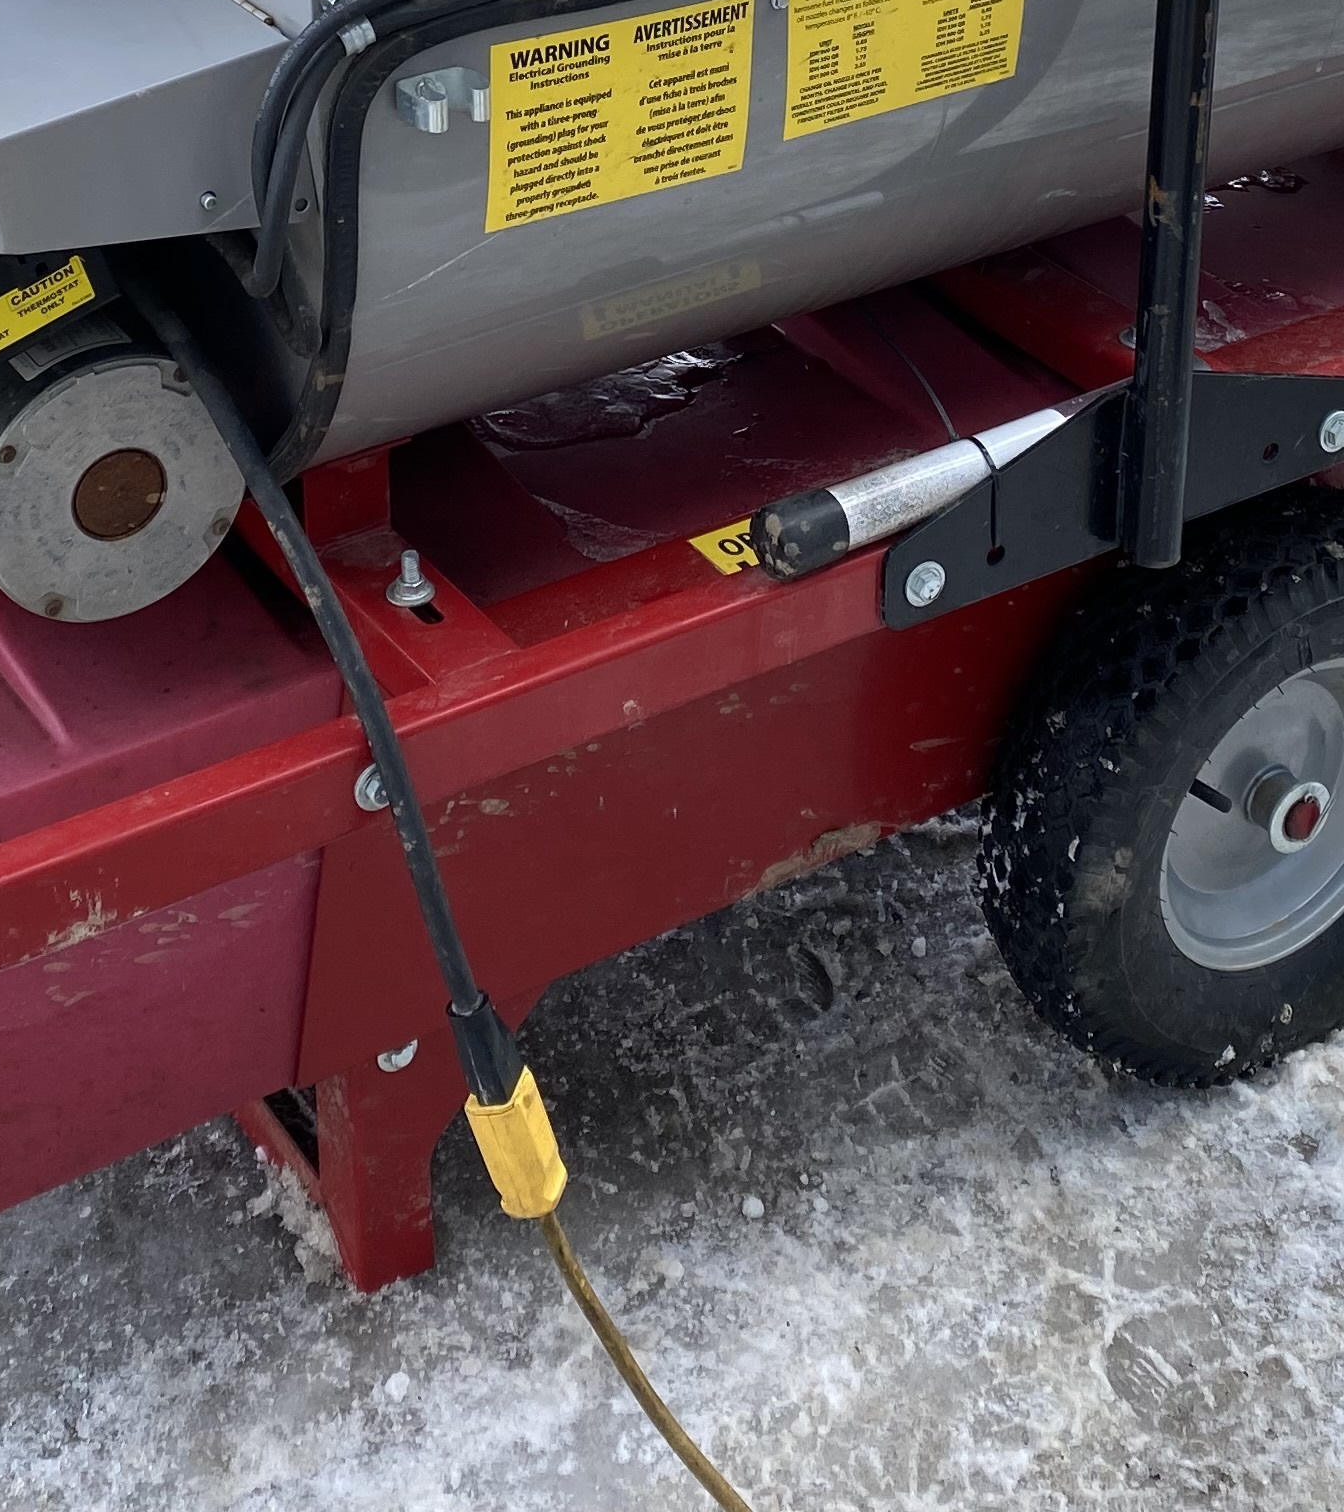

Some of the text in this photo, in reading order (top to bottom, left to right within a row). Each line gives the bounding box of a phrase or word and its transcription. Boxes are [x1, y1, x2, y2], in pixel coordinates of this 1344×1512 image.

[633, 0, 749, 44] AVERTISSEMENT
[509, 33, 610, 69] WARNING
[646, 25, 735, 52] Instructions pour la
[657, 40, 723, 61] mise à la terre
[508, 55, 610, 82] Electrical Grounding
[530, 71, 590, 90] Instructions
[505, 87, 612, 120] This appliance is equipped
[506, 120, 609, 152] (grounding) plug for your
[509, 176, 544, 195] plugged
[544, 169, 576, 184] directly
[576, 166, 594, 176] into
[10, 264, 74, 306] CAUTION
[16, 278, 79, 317] THERMOSTAT
[40, 296, 64, 314] ONLY
